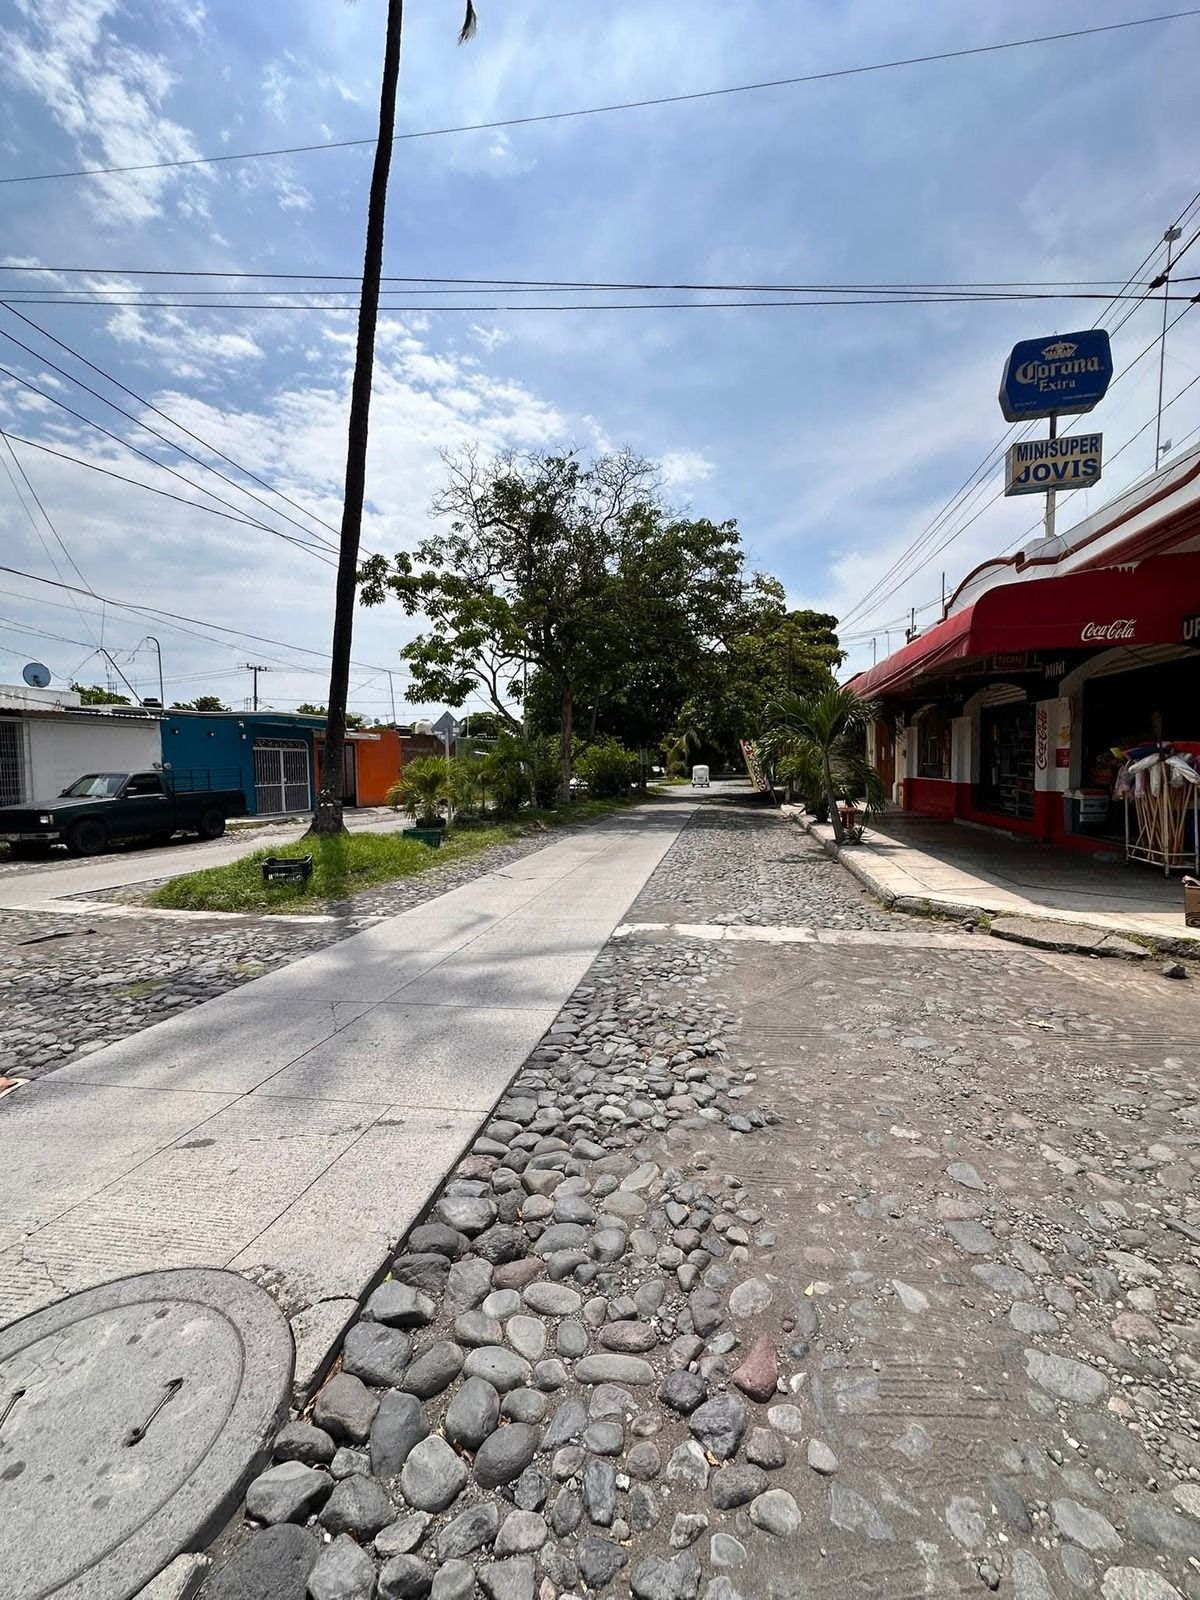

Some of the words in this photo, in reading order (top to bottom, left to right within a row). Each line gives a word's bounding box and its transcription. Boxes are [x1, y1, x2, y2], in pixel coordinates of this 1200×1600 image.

[1016, 357, 1099, 384] Corona
[1040, 379, 1076, 392] Extra
[1017, 436, 1099, 462] MINISUPER
[1017, 458, 1098, 483] JOVIS
